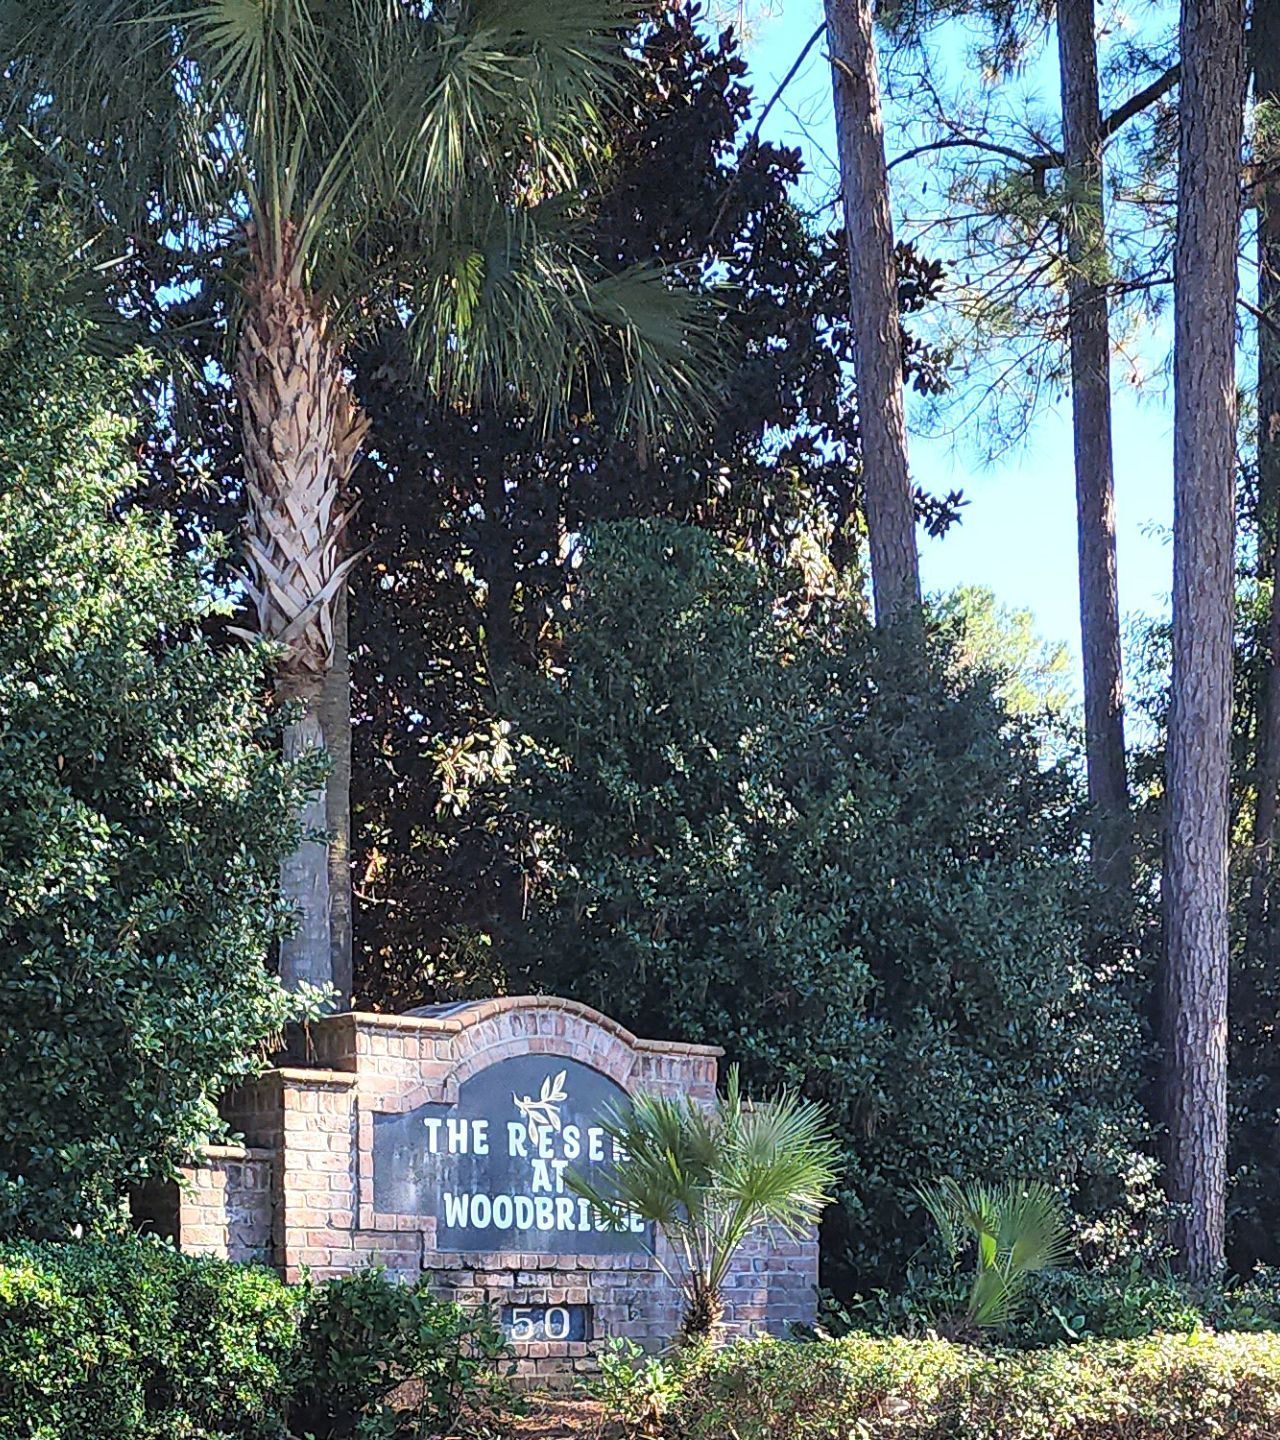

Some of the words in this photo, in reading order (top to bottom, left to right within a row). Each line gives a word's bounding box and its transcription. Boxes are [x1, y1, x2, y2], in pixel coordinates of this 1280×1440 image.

[423, 1118, 489, 1155] THE
[506, 1122, 667, 1162] RESER
[531, 1158, 568, 1194] AT
[511, 1306, 570, 1340] 50
